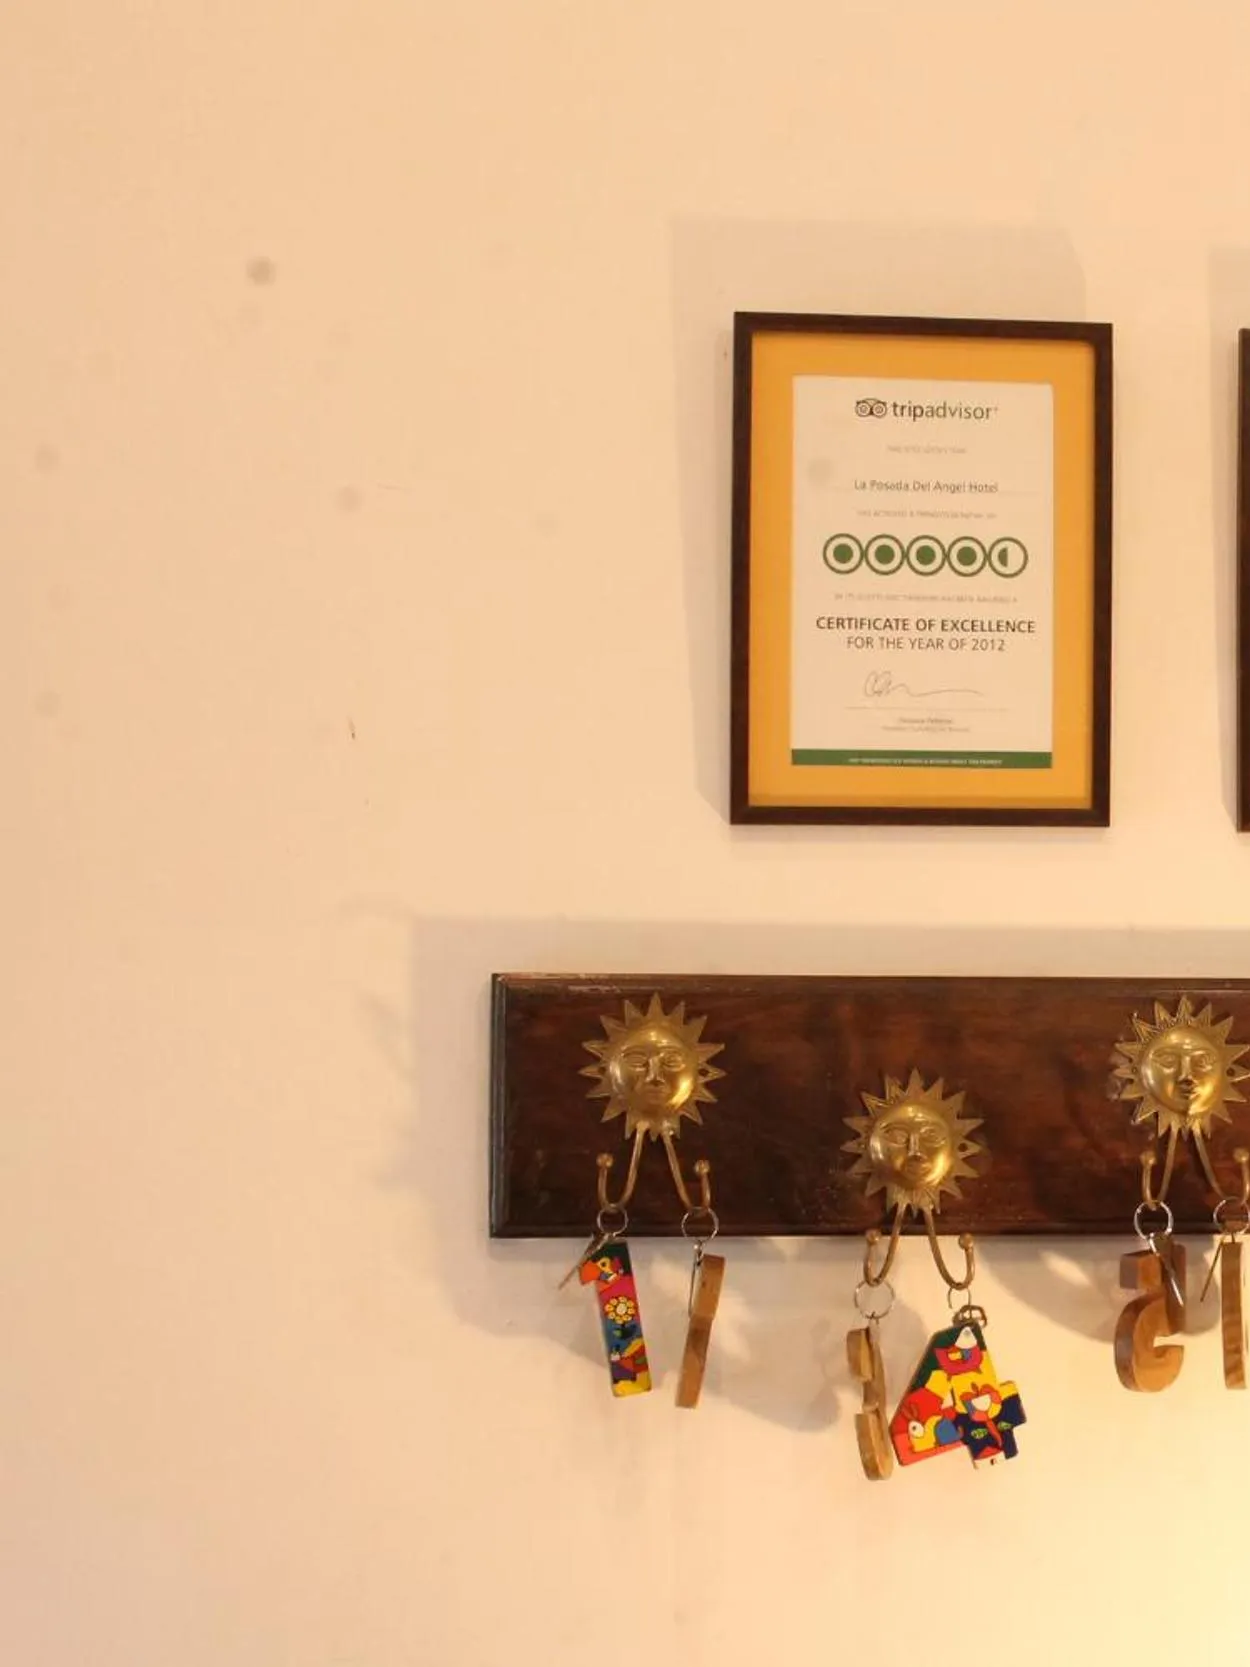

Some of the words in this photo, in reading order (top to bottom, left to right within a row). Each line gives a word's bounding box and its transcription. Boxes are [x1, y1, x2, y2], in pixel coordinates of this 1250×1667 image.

[892, 400, 992, 422] tripadvisor
[854, 480, 867, 491] La
[912, 481, 930, 492] Del
[934, 481, 966, 495] Angel
[969, 482, 999, 494] Hotel
[816, 616, 910, 632] CERTIFICATE
[915, 618, 936, 633] OF
[941, 618, 1036, 634] EXCELLENCE
[847, 636, 874, 650] FOR
[879, 636, 904, 650] THE
[909, 637, 944, 651] YEAR
[949, 638, 968, 651] OF
[972, 638, 1006, 652] 2012
